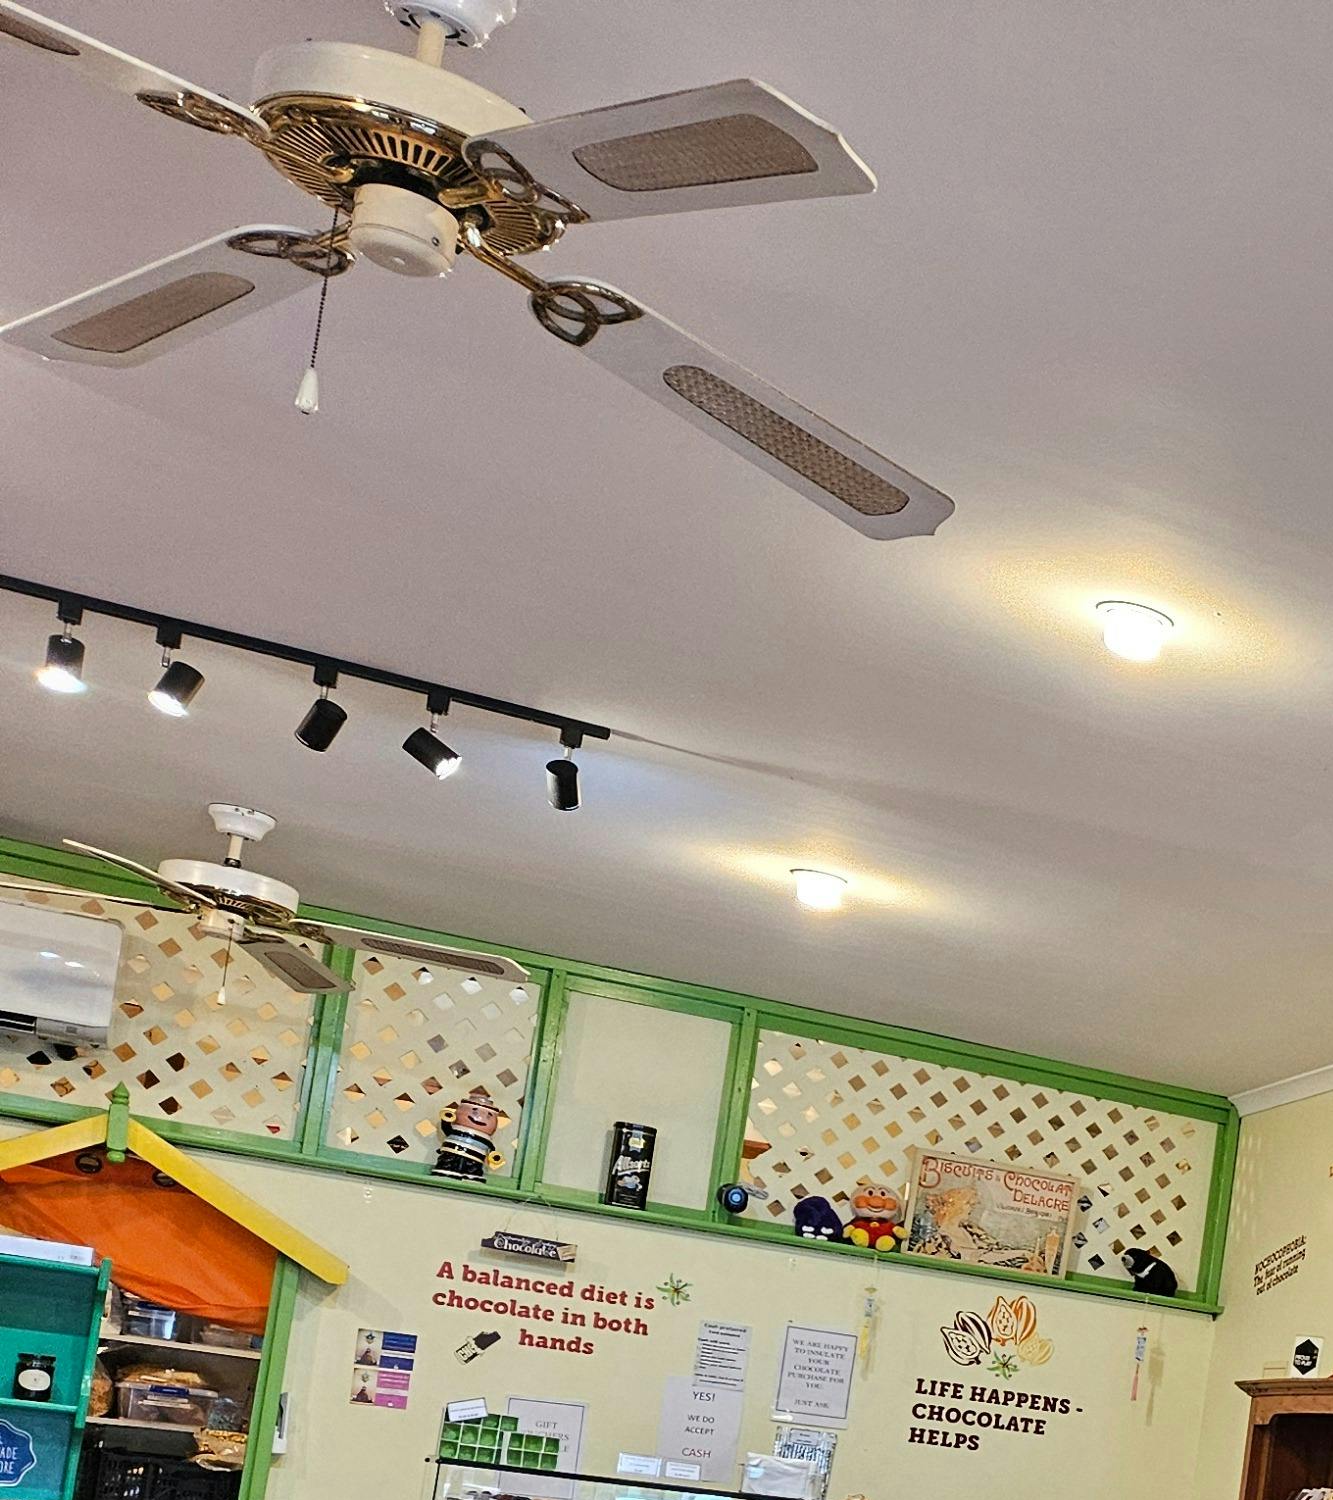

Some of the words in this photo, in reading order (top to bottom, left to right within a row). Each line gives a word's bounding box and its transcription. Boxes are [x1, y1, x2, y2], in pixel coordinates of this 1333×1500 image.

[919, 1156, 995, 1189] BISCUITS
[1003, 1171, 1074, 1198] CHOCOLAT
[1013, 1189, 1070, 1213] DELACRE
[436, 1261, 455, 1280] A
[462, 1264, 574, 1299] balanced
[580, 1283, 629, 1309] diet
[634, 1291, 656, 1311] is
[432, 1289, 555, 1323] chocolate
[561, 1307, 586, 1327] in
[593, 1311, 649, 1337] both
[518, 1328, 595, 1356] hands
[823, 1342, 849, 1352] HAPPY
[794, 1364, 842, 1376] CHOCOLATE
[692, 1391, 716, 1402] YES!
[915, 1378, 965, 1400] LIFE
[969, 1386, 1071, 1415] HAPPENS
[535, 1420, 558, 1429] GIFT
[684, 1426, 715, 1436] ACCEPT
[687, 1414, 701, 1424] WE
[702, 1415, 715, 1424] DO
[912, 1403, 1047, 1436] CHOCOLATE
[908, 1427, 980, 1451] HELPS
[681, 1447, 712, 1459] CASH
